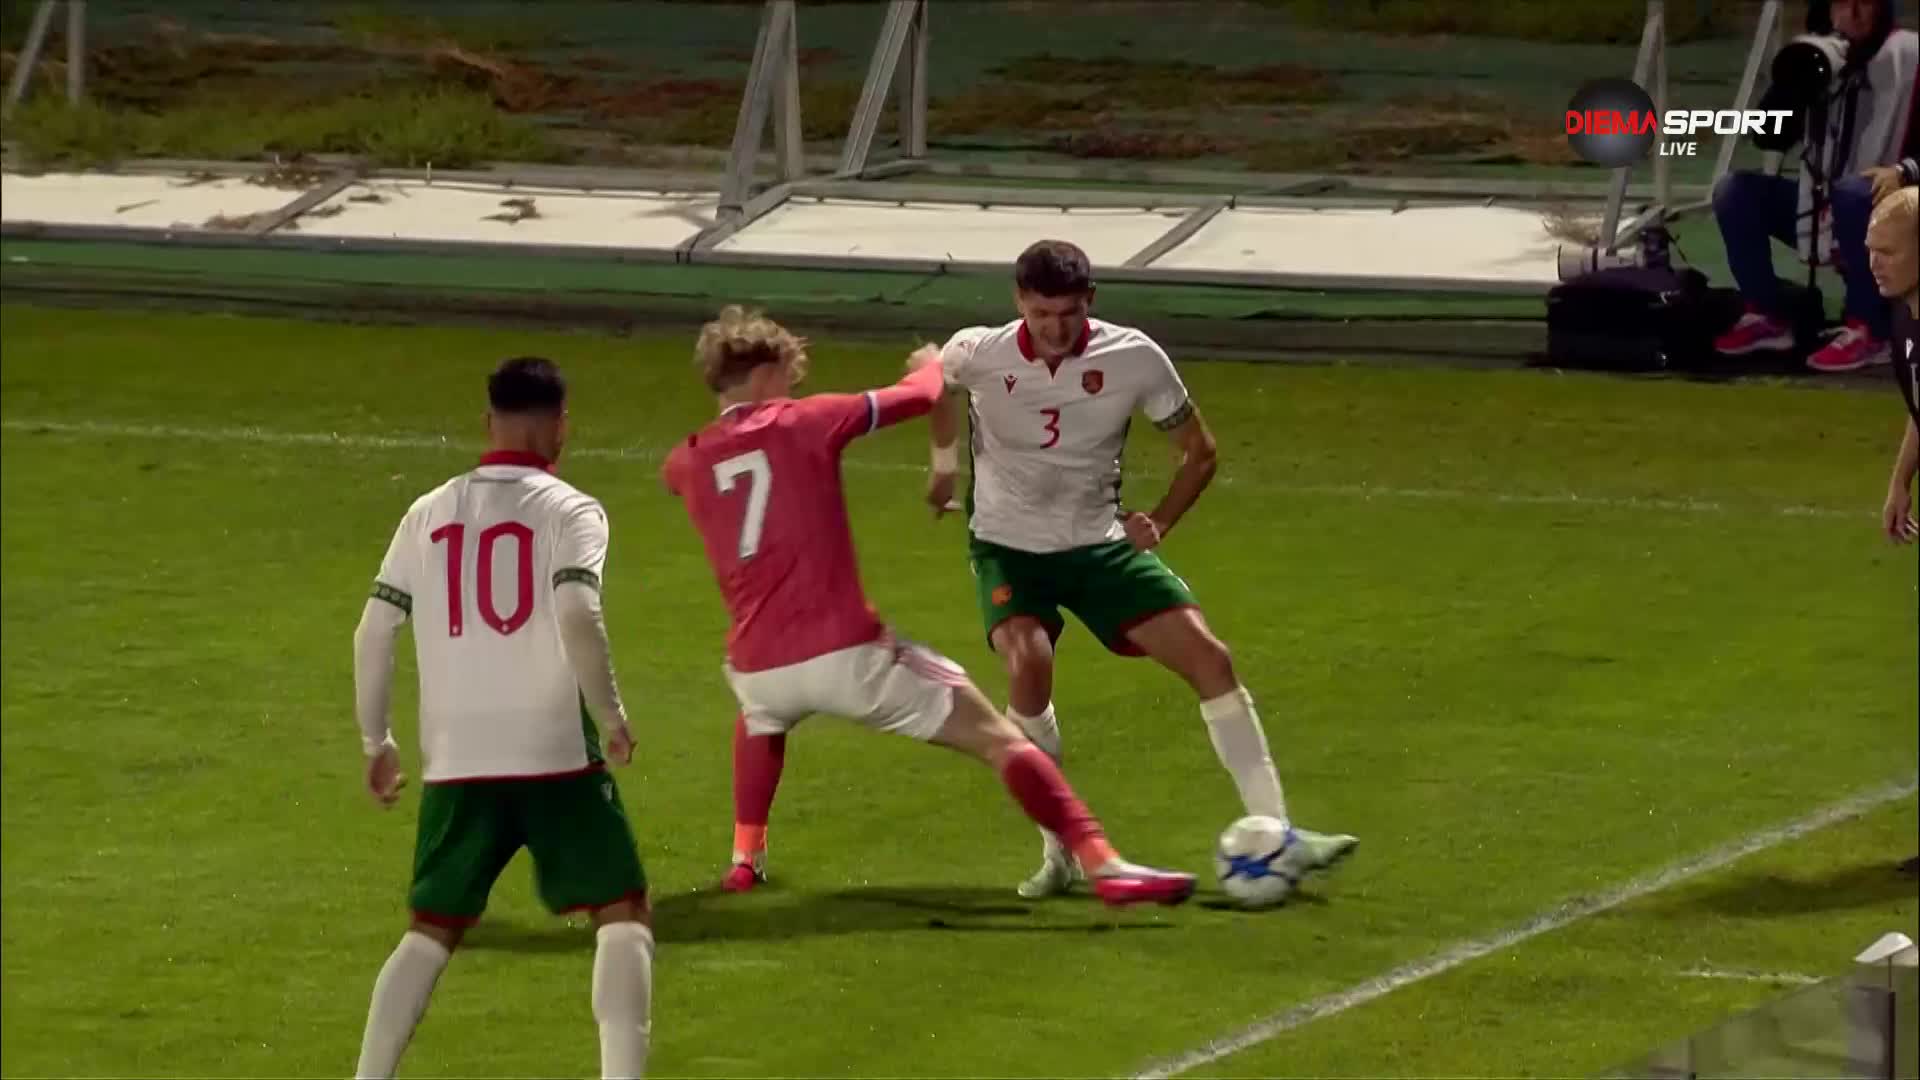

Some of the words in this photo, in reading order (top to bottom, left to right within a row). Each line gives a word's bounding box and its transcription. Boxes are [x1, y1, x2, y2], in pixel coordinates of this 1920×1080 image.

[1039, 408, 1061, 449] 3
[711, 449, 772, 560] 7
[430, 521, 534, 637] 10
